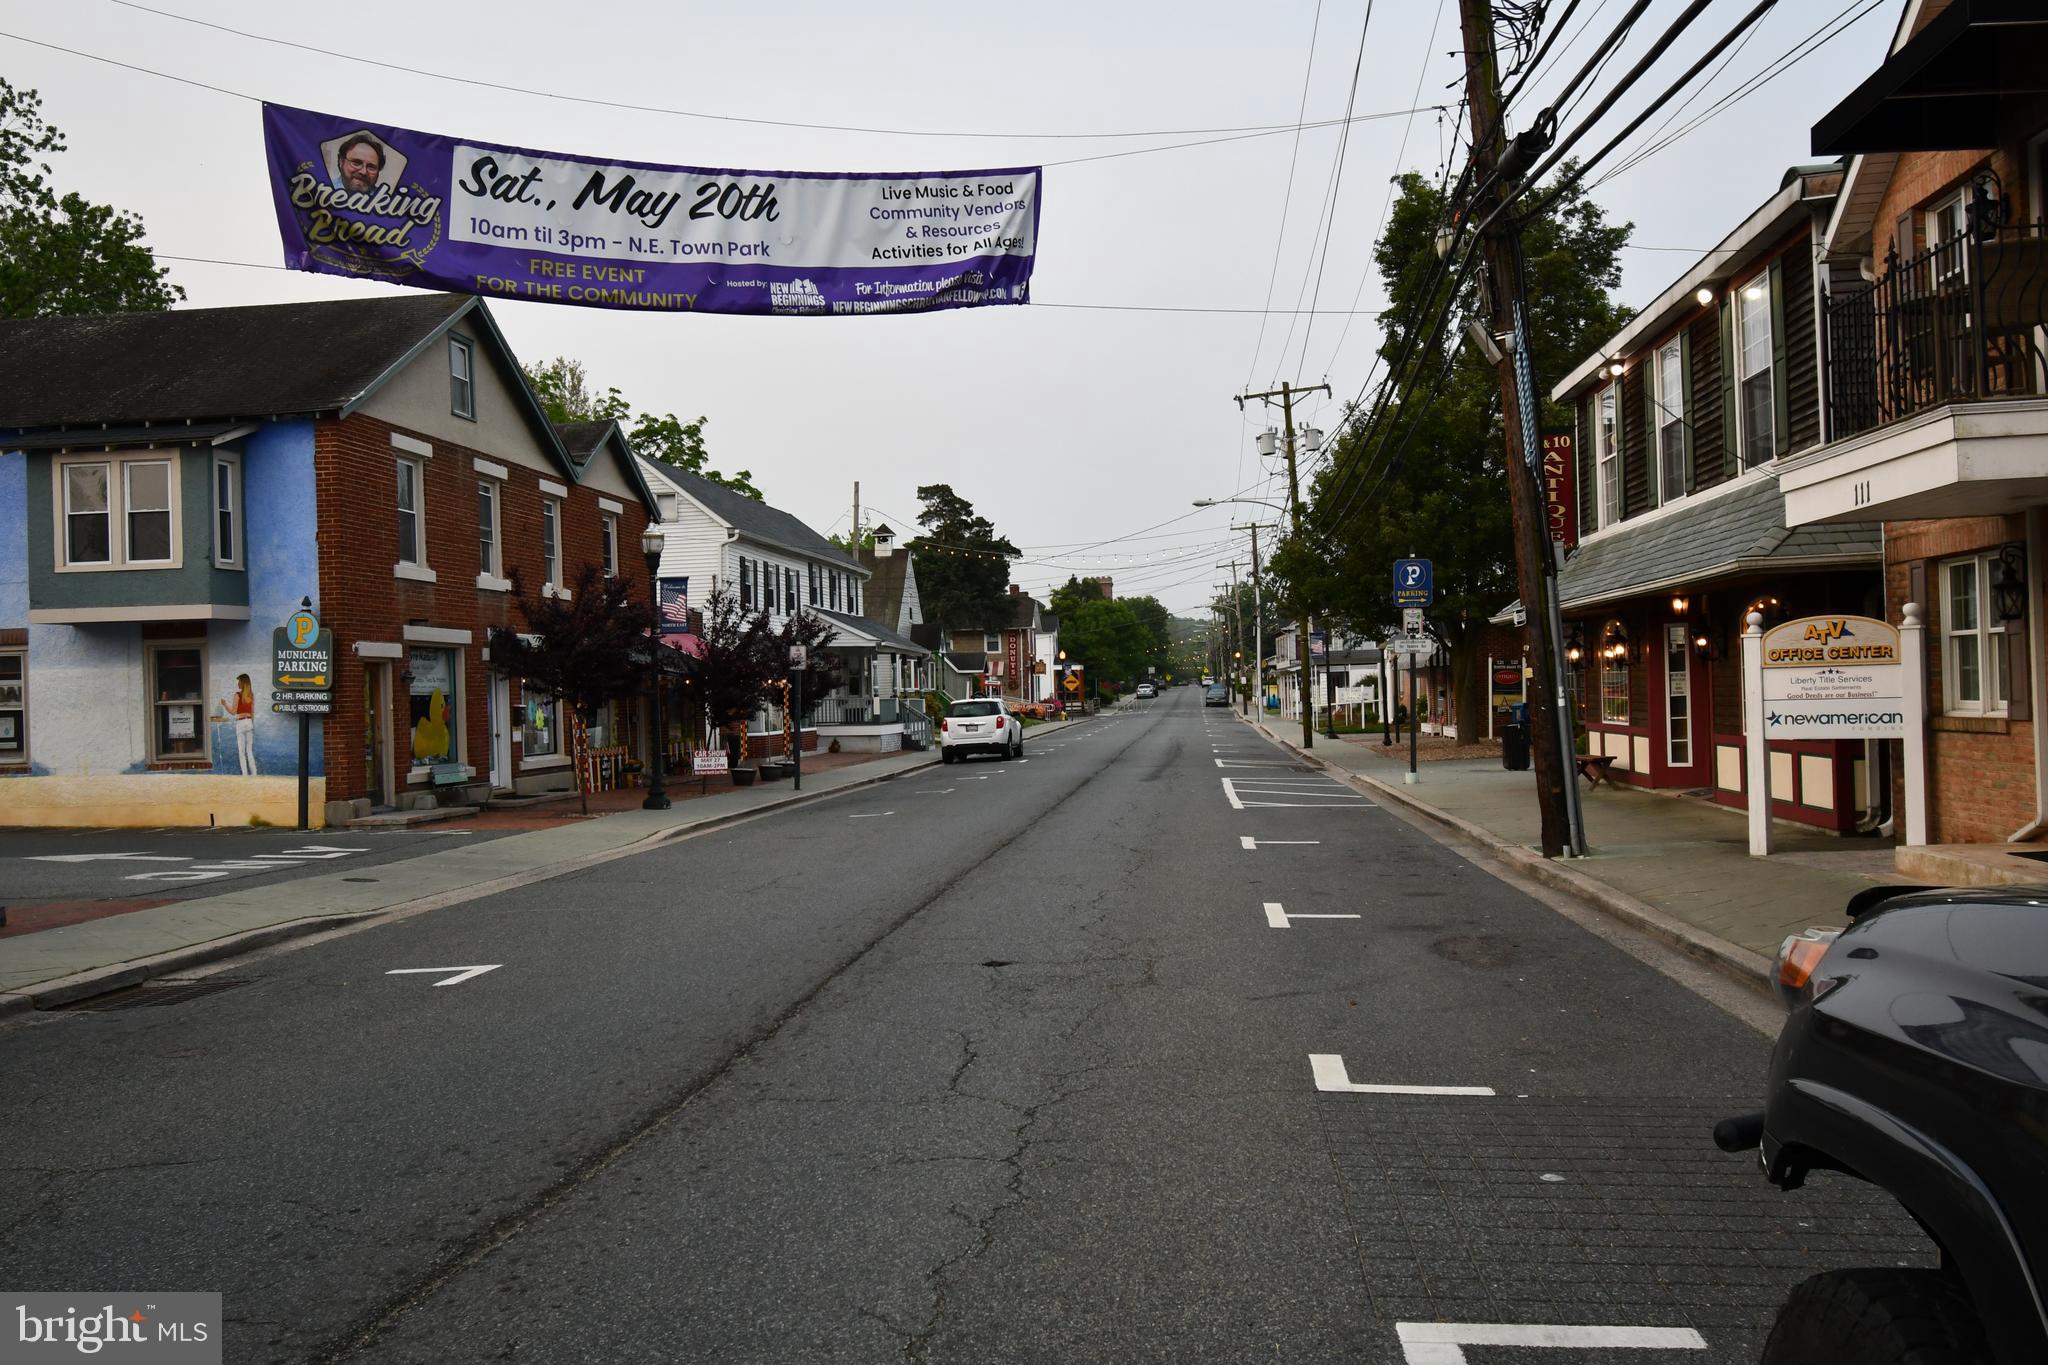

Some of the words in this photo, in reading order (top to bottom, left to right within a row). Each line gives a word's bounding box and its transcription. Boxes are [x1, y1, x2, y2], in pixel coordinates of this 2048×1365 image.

[290, 172, 442, 225] Breaking
[459, 156, 556, 211] Sat.,
[572, 170, 681, 228] May
[689, 182, 779, 221] 20th
[882, 186, 912, 200] Live
[915, 185, 959, 199] Music
[962, 185, 974, 197] &
[977, 183, 1014, 196] Food
[870, 204, 960, 221] Community
[964, 199, 1026, 217] Vendors
[309, 209, 412, 247] Bread
[470, 217, 528, 241] 10am
[534, 226, 552, 244] til
[558, 230, 606, 252] 3pm
[629, 237, 664, 254] N.E.
[670, 239, 723, 256] Town
[727, 241, 770, 257] Park
[906, 226, 918, 239] &
[922, 221, 1001, 238] Resources
[872, 244, 943, 260] Activities
[947, 243, 968, 256] for
[973, 237, 992, 251] All
[995, 236, 1025, 251] Ages!
[530, 258, 577, 278] FREE
[582, 263, 645, 283] EVENT
[476, 275, 517, 294] FOR
[523, 281, 562, 299] THE
[567, 284, 697, 308] COMMUNITY
[727, 280, 756, 288] Hosted
[757, 279, 768, 288] by:
[770, 281, 789, 294] NEW
[854, 282, 873, 295] For
[874, 279, 934, 297] Information
[771, 294, 826, 306] BEGINNINGS
[1543, 439, 1550, 448] &
[1553, 436, 1571, 448] 10
[1855, 480, 1870, 506] 111
[1406, 566, 1420, 585] P
[295, 617, 313, 643] P
[1804, 620, 1846, 645] ATV
[278, 650, 328, 660] MUNICIPAL
[1769, 648, 1824, 662] OFFICE
[1828, 645, 1893, 659] CENTER
[278, 661, 327, 672] PARKING
[1820, 676, 1835, 684] Title
[1837, 675, 1872, 683] Services
[276, 692, 281, 700] 2
[279, 704, 296, 712] PUBLIC
[1784, 712, 1903, 725] newamerican
